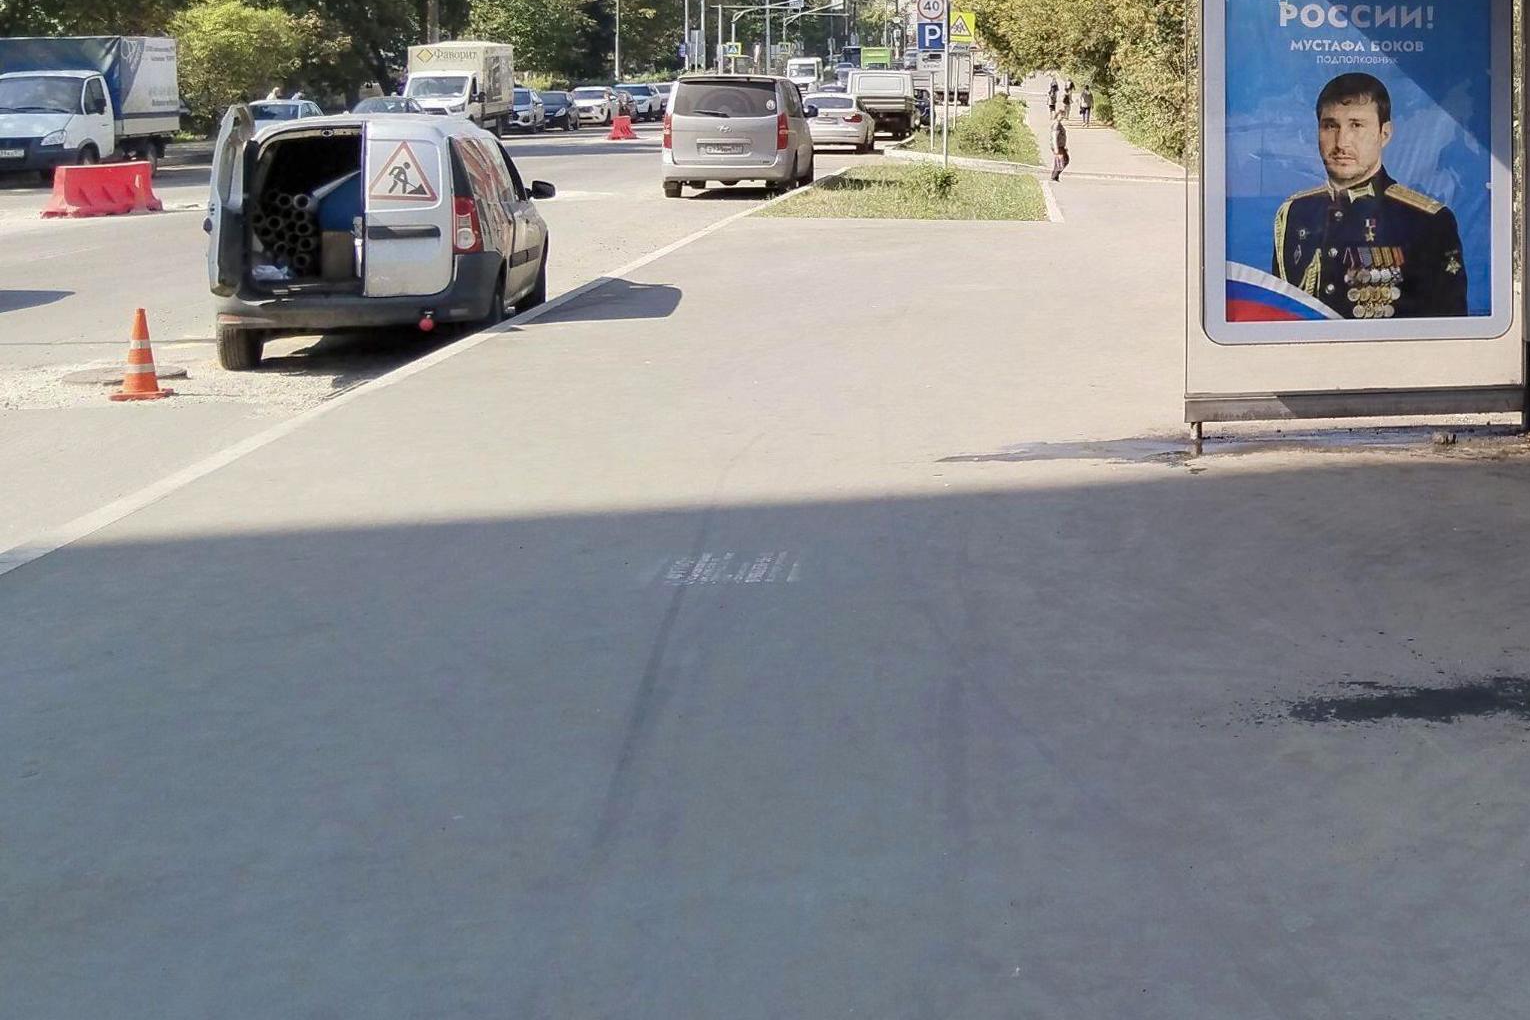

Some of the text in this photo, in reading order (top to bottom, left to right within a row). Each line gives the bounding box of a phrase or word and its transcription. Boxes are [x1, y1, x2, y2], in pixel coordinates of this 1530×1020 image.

[924, 0, 940, 11] 40
[1279, 2, 1434, 29] РОССИИ!
[1290, 40, 1424, 52] МУСТАФА БОКОВ
